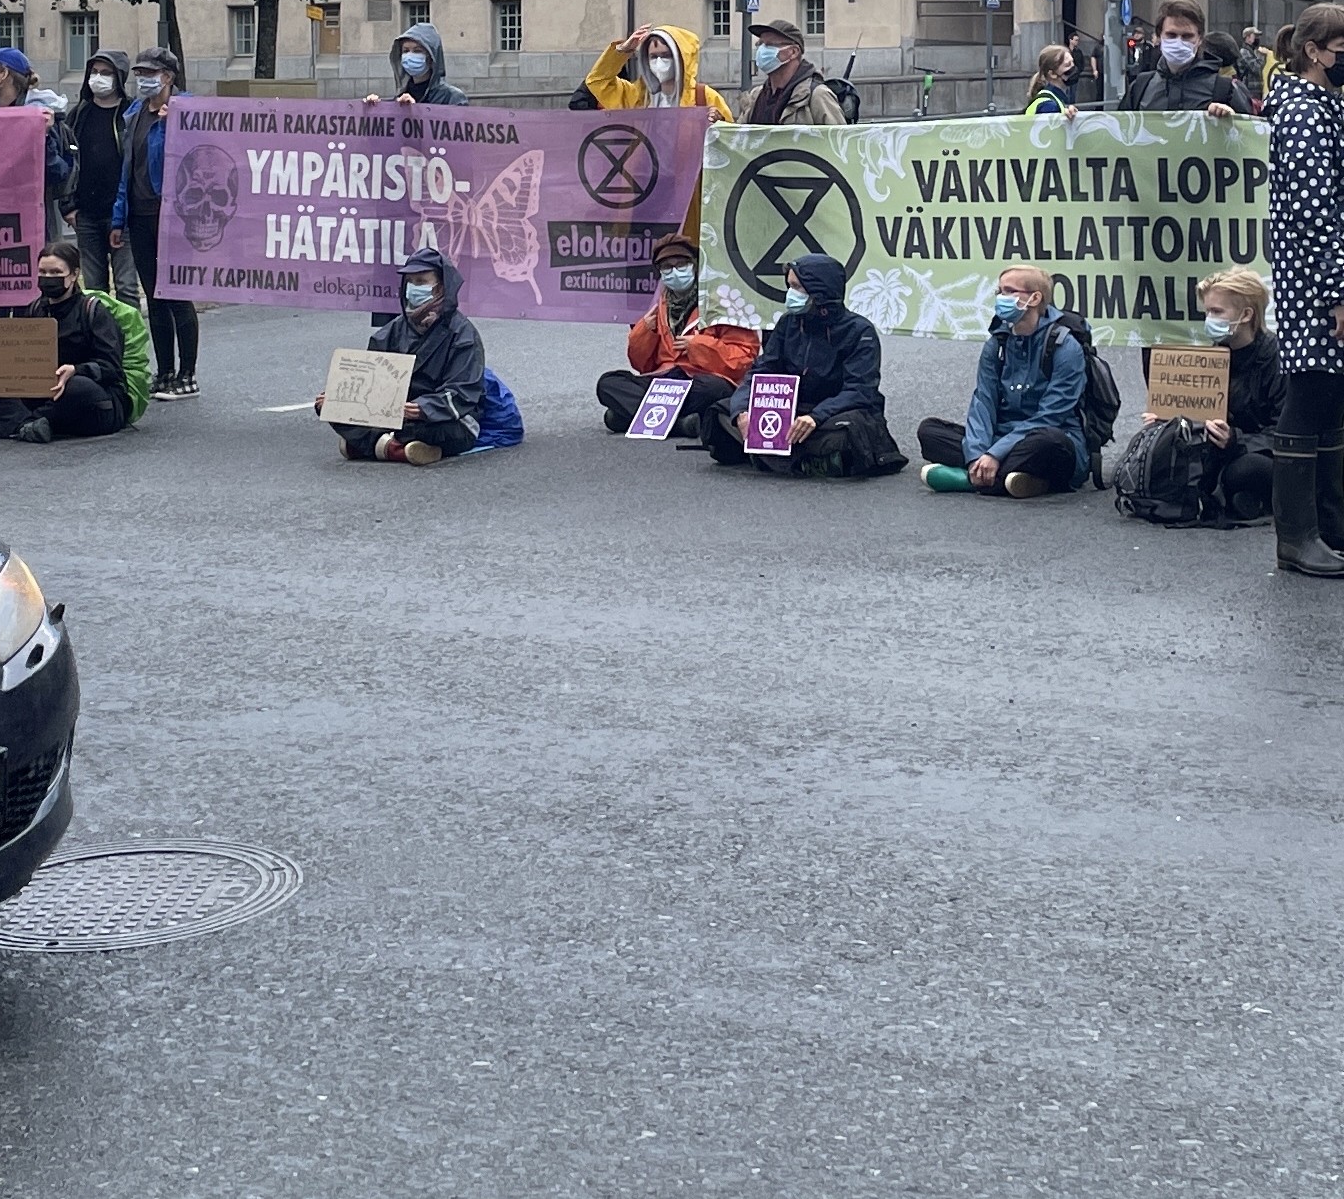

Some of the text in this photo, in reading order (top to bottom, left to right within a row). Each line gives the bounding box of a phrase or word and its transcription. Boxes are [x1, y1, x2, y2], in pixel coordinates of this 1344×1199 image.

[180, 108, 520, 144] KAIKKI MITÄ RAKASTAMME ON VAARASSA
[246, 141, 471, 204] YMPÄRISTÖ-
[912, 149, 1269, 204] VÄKIVALTA LOPP
[265, 204, 439, 266] HÄTÄTILA
[556, 225, 657, 261] elokapi
[169, 265, 400, 300] LIITY KAPINAAN elokapina.
[564, 272, 631, 291] extinction
[1051, 273, 1205, 321] OIMALL
[1153, 353, 1230, 369] ELINKELPOINEN
[755, 383, 794, 395] ILMASTO-
[1160, 372, 1222, 389] PLANEETTA
[754, 396, 791, 410] HÄTÄTILA
